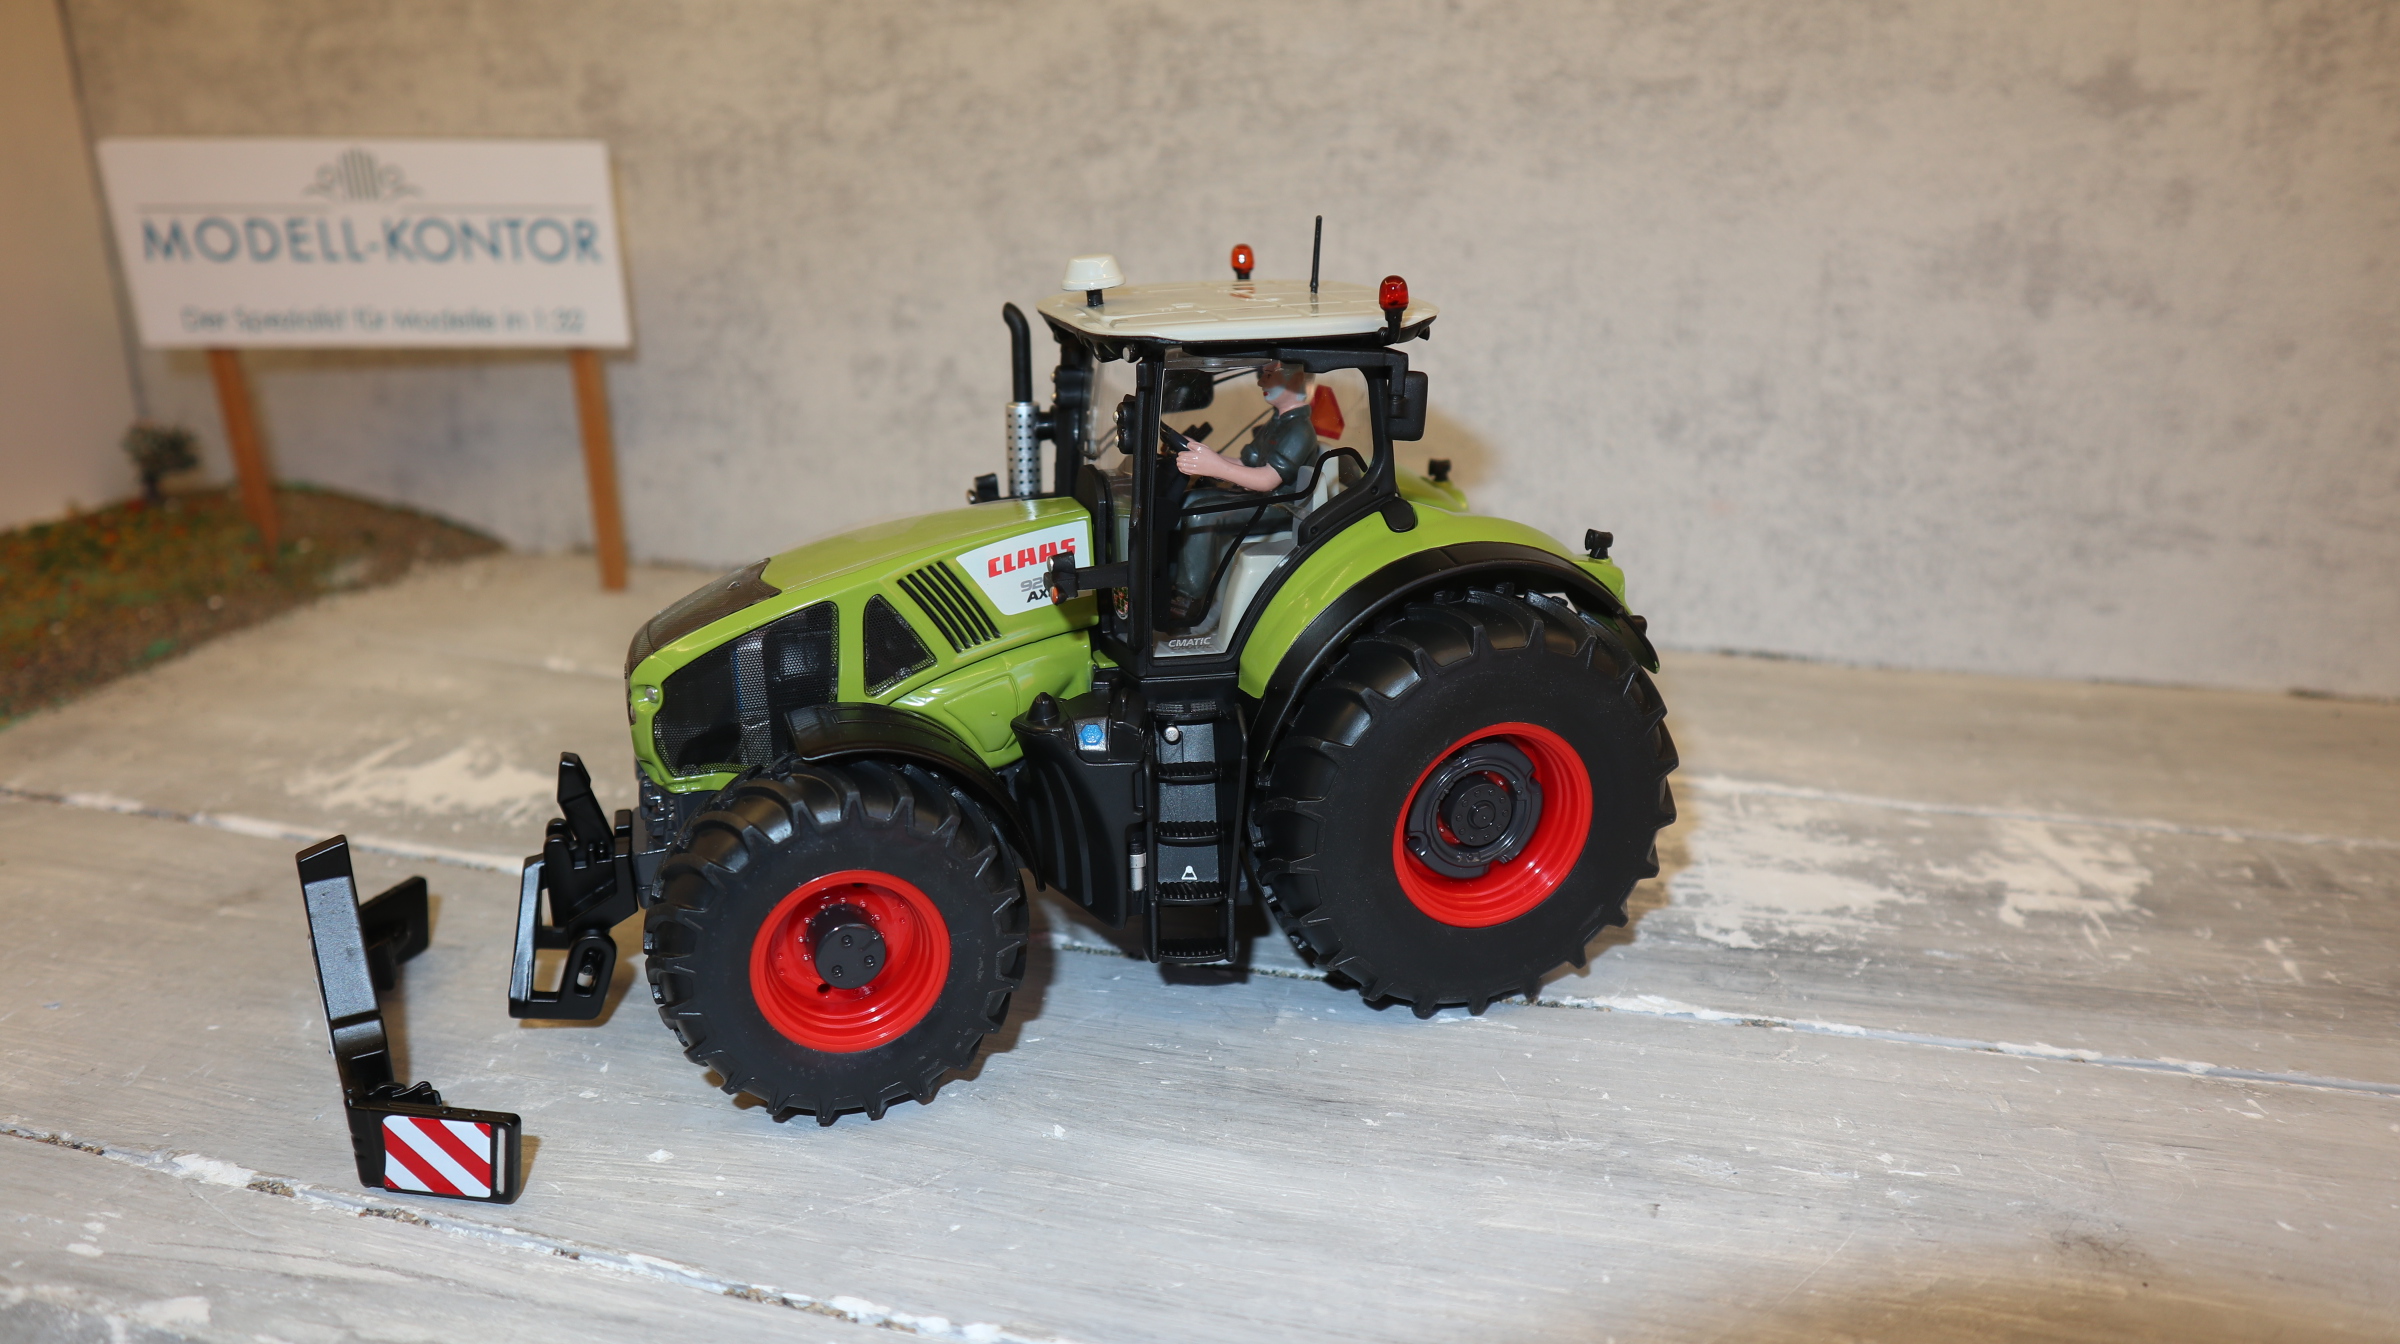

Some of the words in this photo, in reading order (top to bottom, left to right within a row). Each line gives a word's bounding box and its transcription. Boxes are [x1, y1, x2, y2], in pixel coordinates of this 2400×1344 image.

[141, 216, 604, 265] MODELL-KONTOR
[987, 537, 1076, 578] CLAAS
[1020, 576, 1044, 593] 92
[1168, 636, 1212, 648] CMATIC
